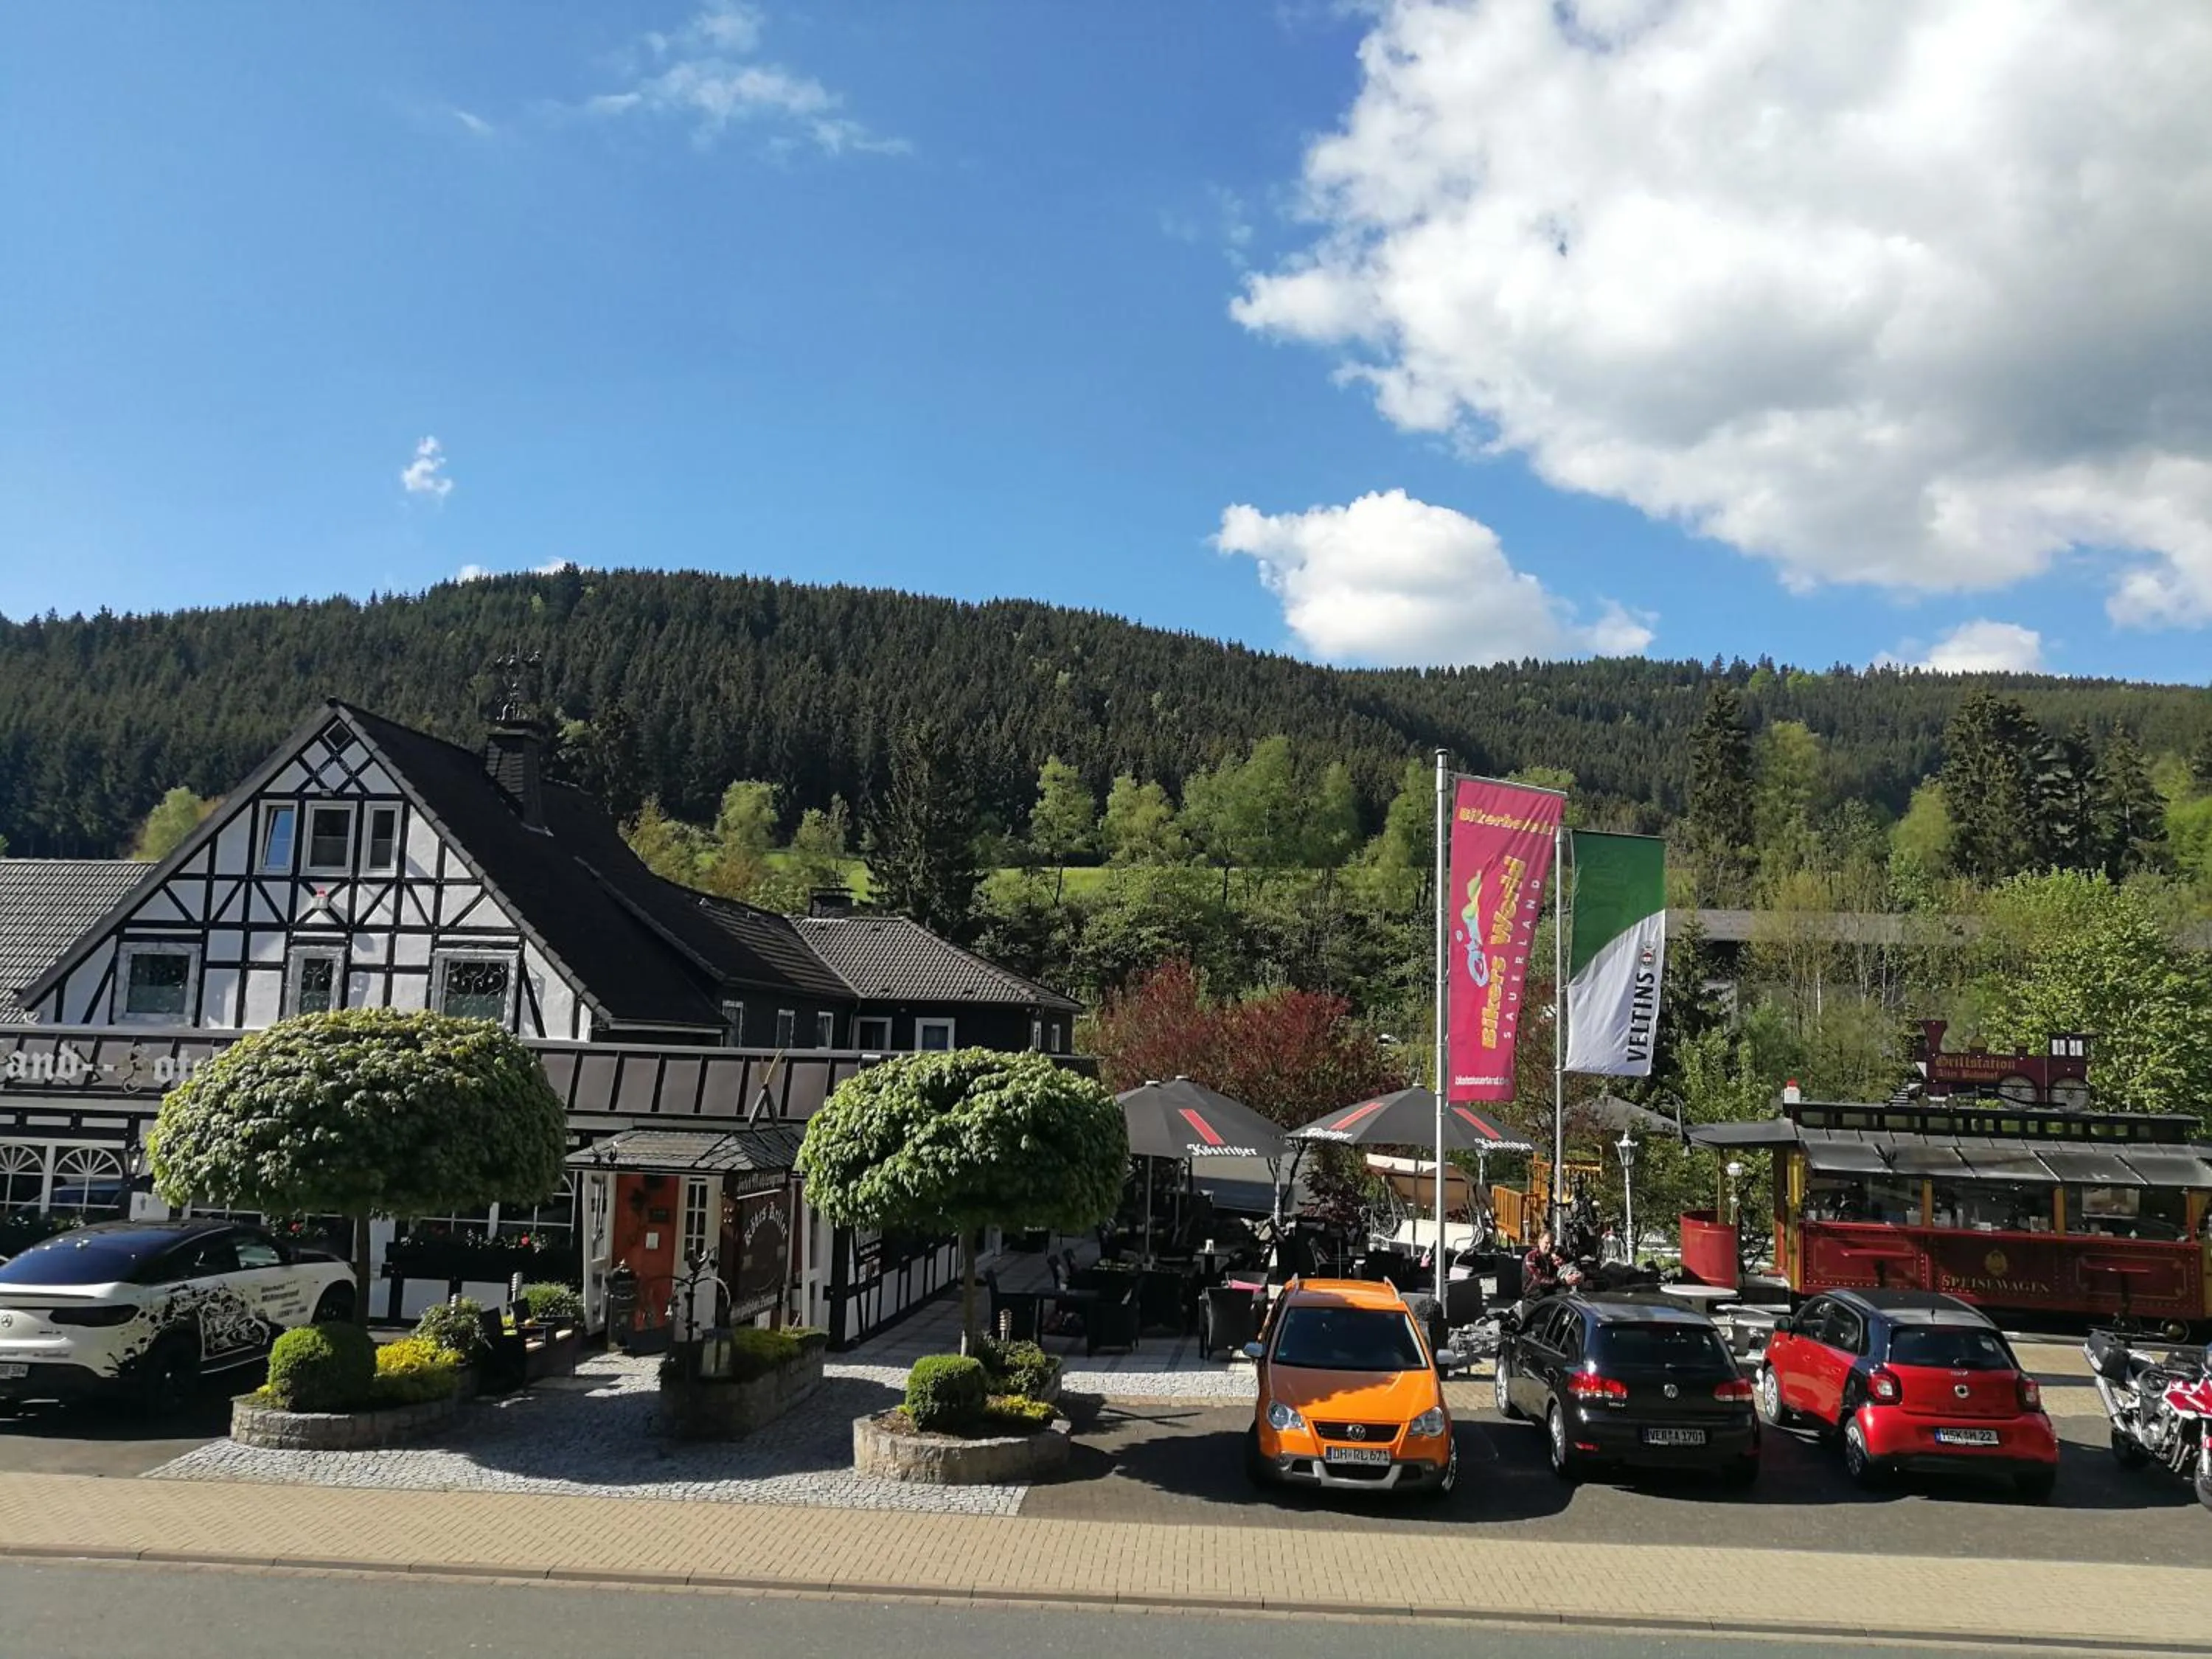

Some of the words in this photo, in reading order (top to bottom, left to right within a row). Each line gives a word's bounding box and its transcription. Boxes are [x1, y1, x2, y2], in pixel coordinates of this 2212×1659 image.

[1481, 956, 1507, 1050] Bikers
[1503, 880, 1542, 1040] SAUERLAND
[1627, 972, 1655, 1062] VELTINS
